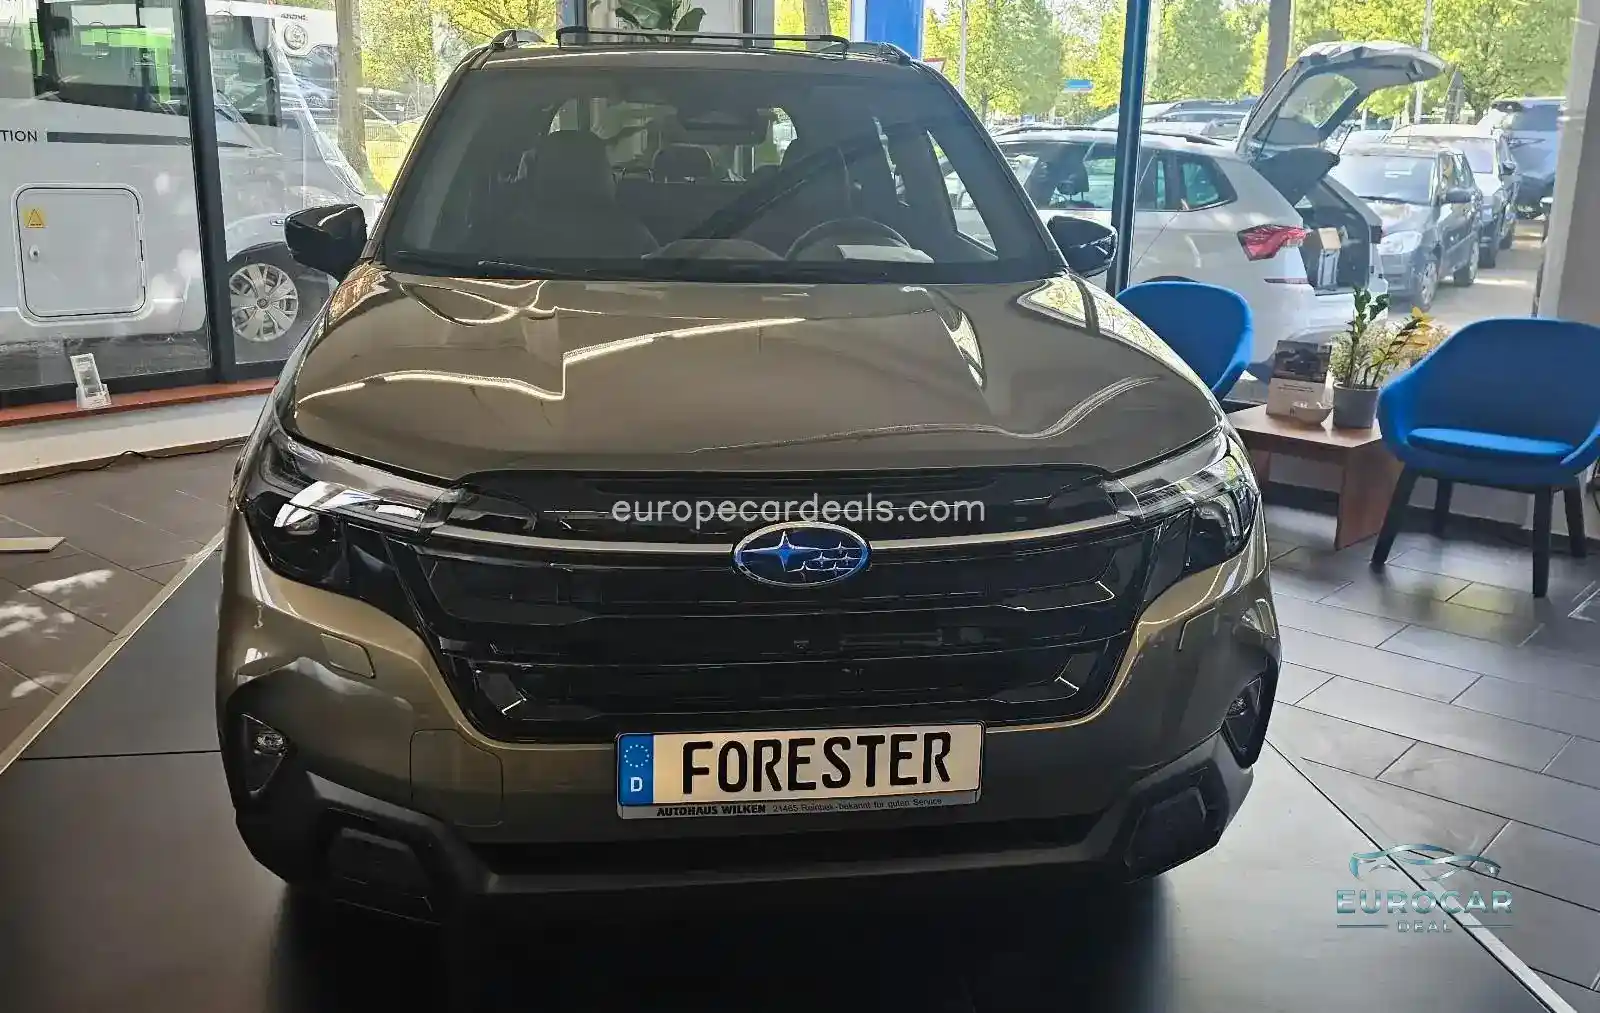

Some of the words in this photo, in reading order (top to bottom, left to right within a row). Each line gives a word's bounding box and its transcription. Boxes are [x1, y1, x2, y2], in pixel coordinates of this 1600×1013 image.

[0, 129, 38, 142] TION
[682, 731, 951, 795] FORESTER
[630, 776, 643, 792] D
[656, 805, 718, 817] AUTOHAUS
[721, 803, 766, 815] WILKEN
[912, 797, 943, 807] Service
